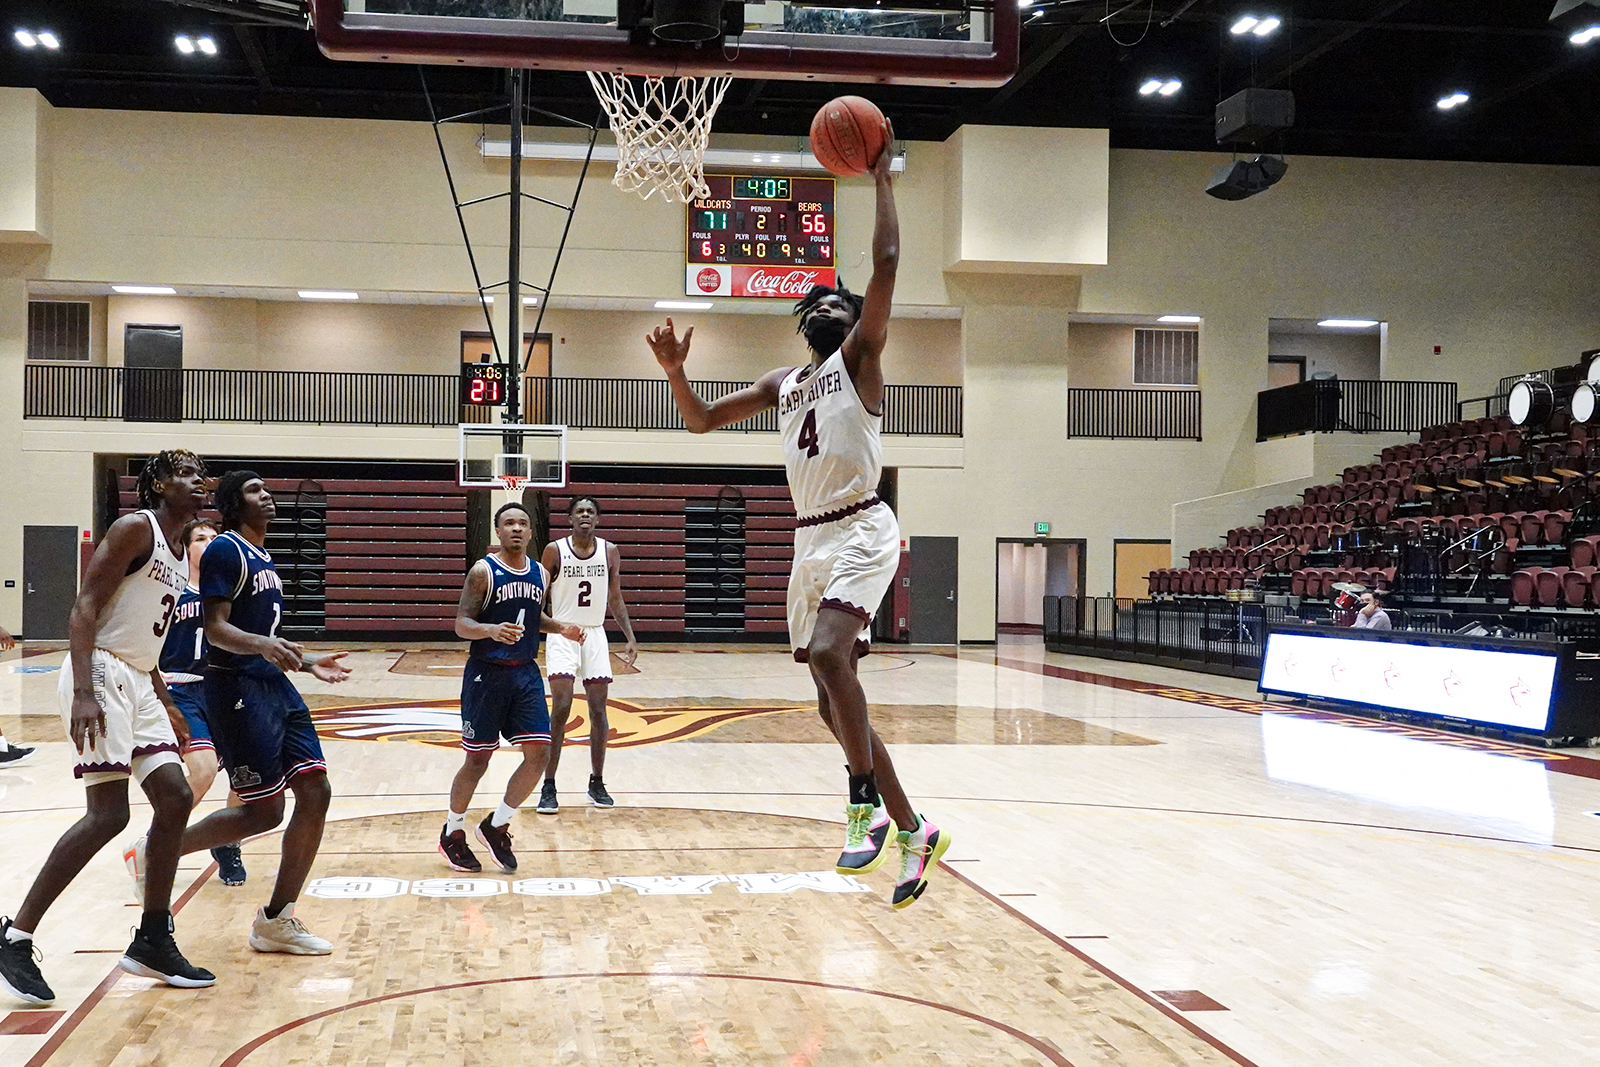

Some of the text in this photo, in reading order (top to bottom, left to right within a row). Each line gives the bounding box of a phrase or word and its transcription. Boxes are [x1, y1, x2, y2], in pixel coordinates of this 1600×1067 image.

[694, 199, 731, 209] WILDCATS
[798, 202, 822, 211] BEARS
[704, 211, 727, 229] 71
[757, 214, 766, 230] 2
[802, 214, 826, 233] 56
[701, 241, 712, 257] 6
[719, 243, 726, 255] 3
[742, 243, 752, 256] 4
[781, 243, 791, 257] 9
[797, 246, 804, 256] 4
[820, 245, 830, 258] 4
[471, 379, 498, 402] 21
[797, 408, 819, 459] 4
[148, 559, 173, 588] PEARL
[563, 564, 605, 577] PEARL RIVER
[495, 581, 543, 605] SOUTHWEST
[577, 580, 592, 607] 2
[153, 593, 175, 637] 3
[175, 601, 200, 624] SOUT
[304, 871, 873, 898] MACCC
